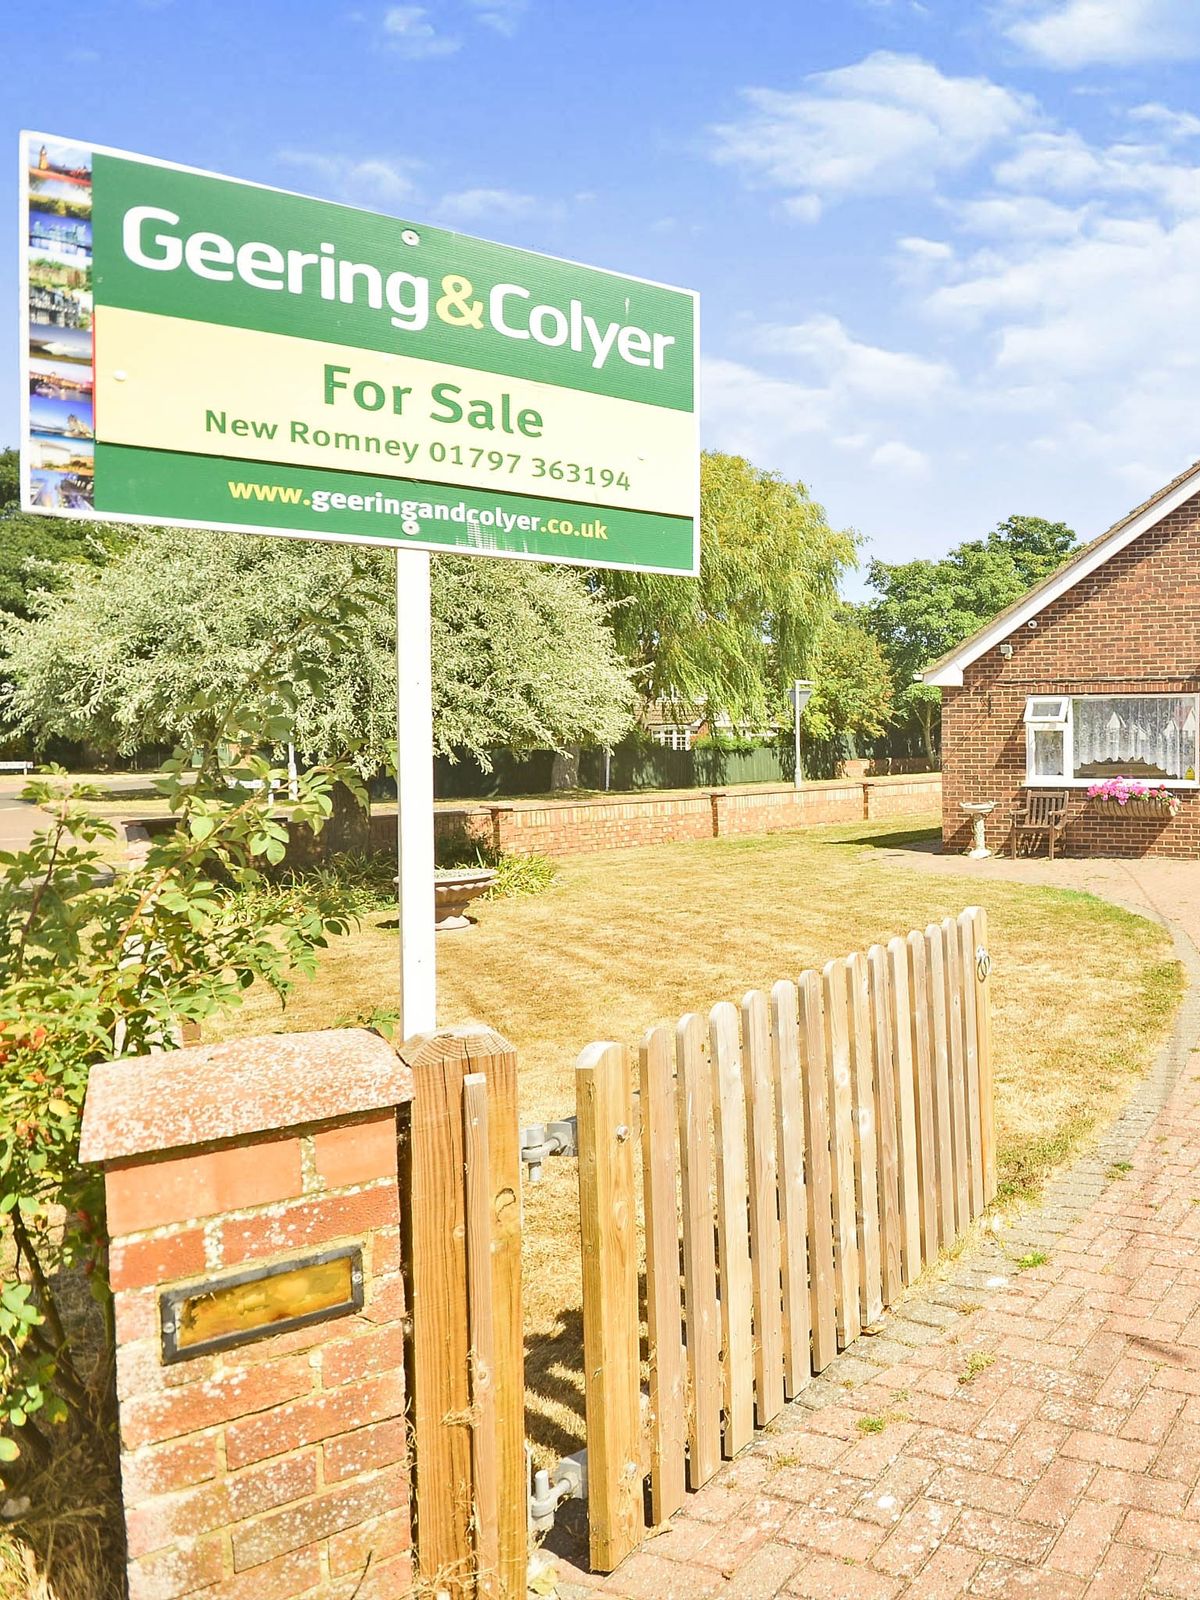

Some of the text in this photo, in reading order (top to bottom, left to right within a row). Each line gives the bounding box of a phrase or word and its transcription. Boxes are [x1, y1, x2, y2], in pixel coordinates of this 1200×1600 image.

[323, 364, 544, 438] For Sale
[205, 409, 631, 491] New Romney 01797 363194
[228, 480, 609, 540] www.geeringandcolyer.co.uk
